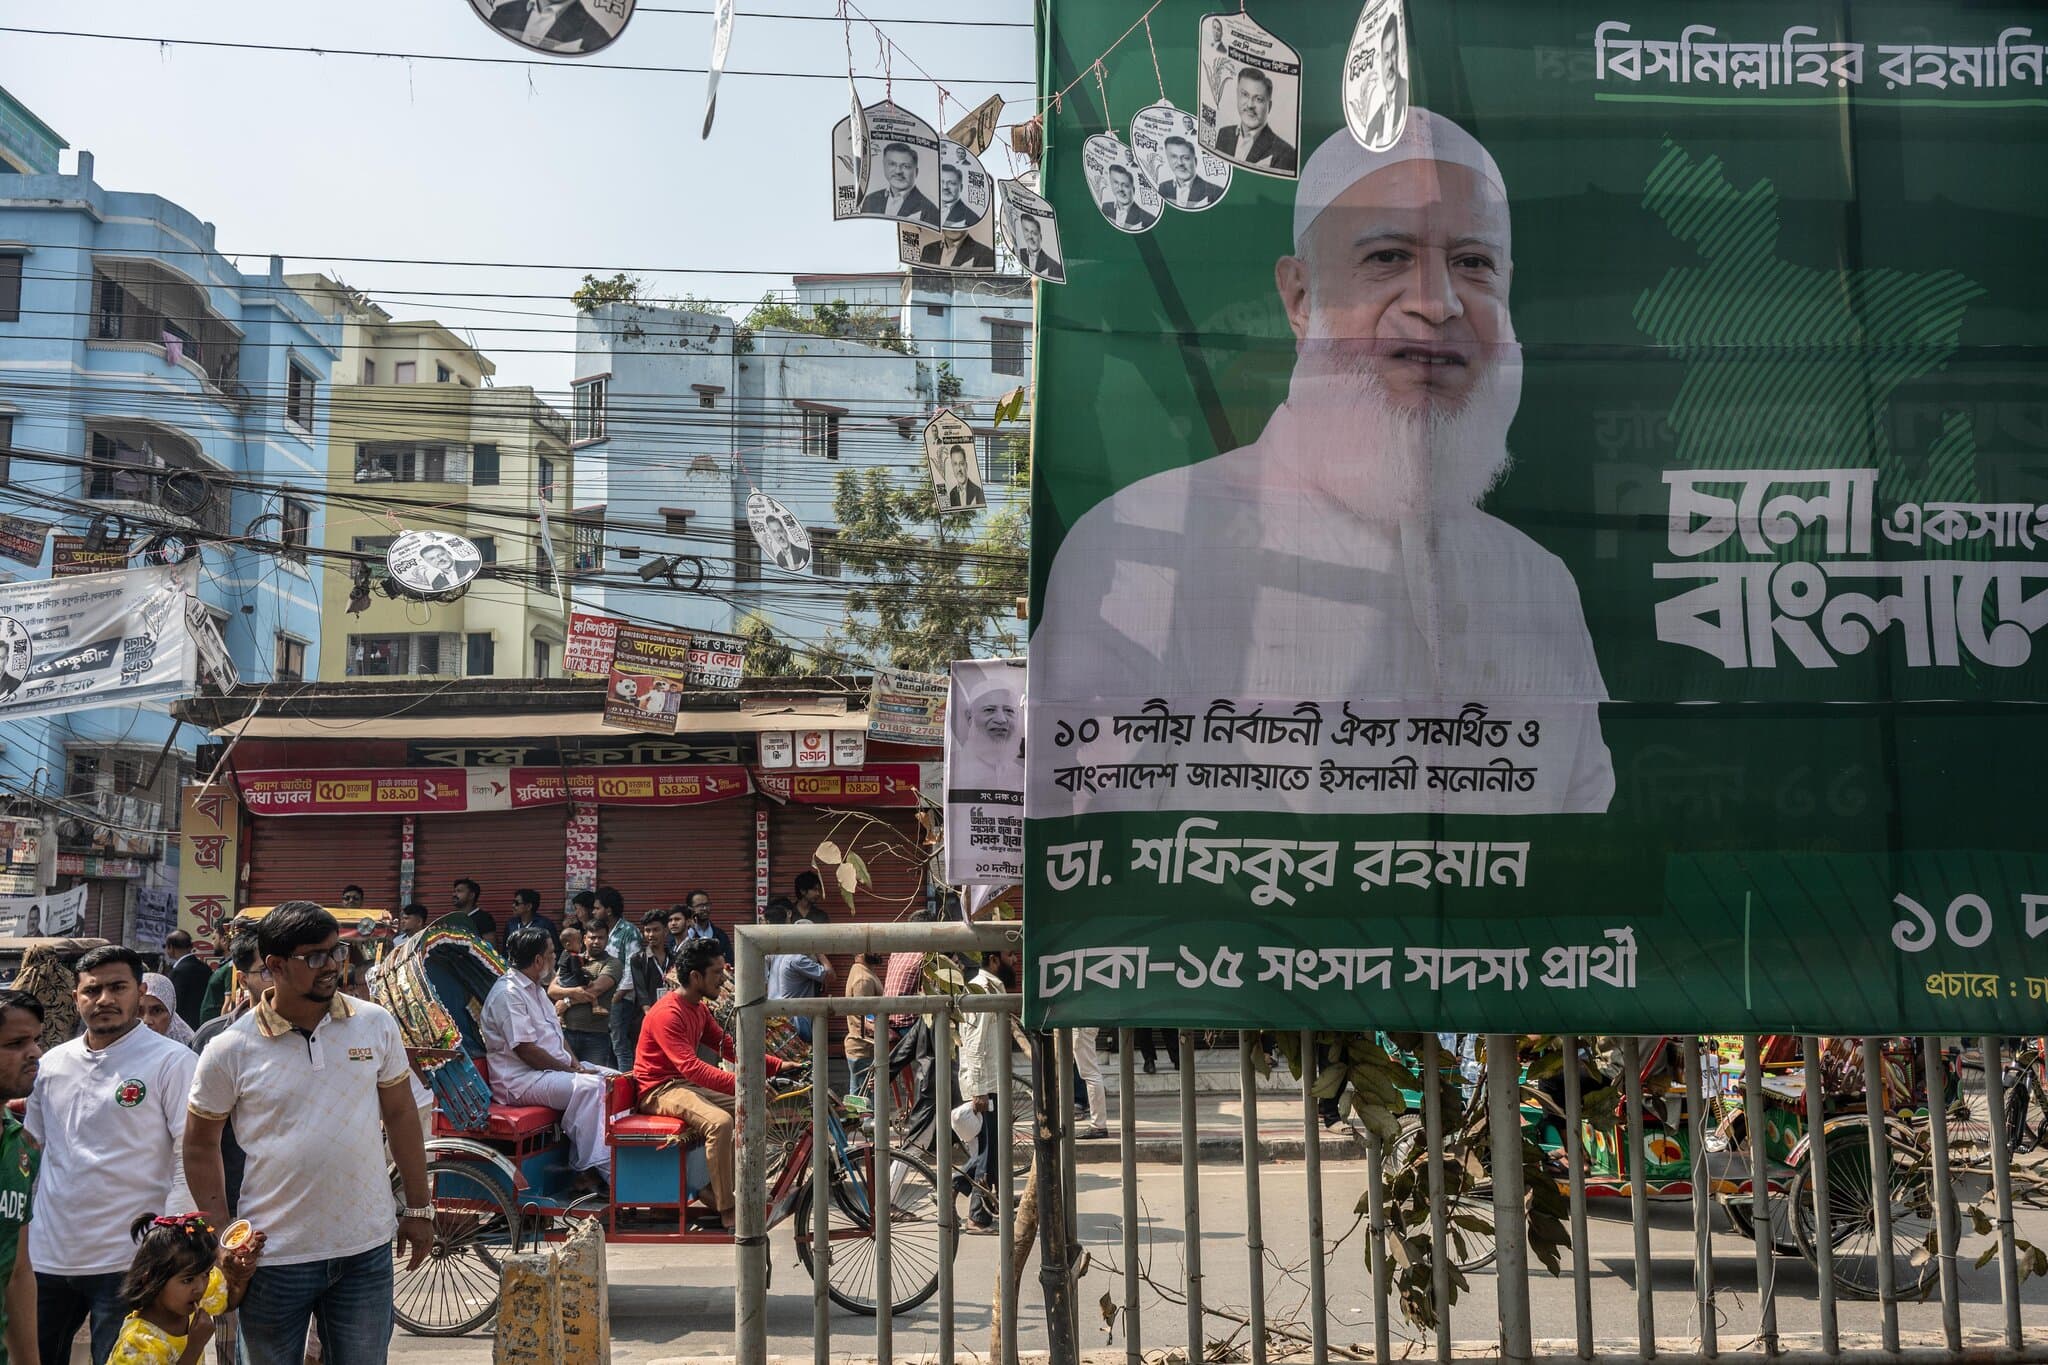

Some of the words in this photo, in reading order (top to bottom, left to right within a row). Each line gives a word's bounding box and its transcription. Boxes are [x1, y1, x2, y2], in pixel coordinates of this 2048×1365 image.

[1594, 20, 1865, 91] বিসমিল্লাহির
[1878, 27, 2048, 91] রহমানি
[1662, 469, 1879, 557] চলো
[633, 640, 686, 661] আলোড়ন
[711, 652, 743, 668] লেখা
[1054, 716, 1100, 747] ১০
[1112, 702, 1195, 747] দলীয়
[1203, 699, 1323, 746] নির্বাচনী
[1331, 700, 1397, 747] ঐক্য
[1406, 703, 1512, 749] সমর্থিত
[1518, 721, 1541, 747] ও
[799, 751, 826, 762] নগদ
[1054, 761, 1179, 795] বাংলাদেশ
[1186, 762, 1312, 792] জামায়াতে
[1319, 756, 1419, 793] ইসলামী
[1426, 757, 1538, 794] মনোনীত
[274, 790, 312, 804] ডাবল
[320, 783, 346, 801] ৫০
[515, 784, 555, 802] সুবিধা
[602, 780, 628, 796] ৫০
[970, 834, 1001, 846] সেবক
[975, 863, 990, 872] ১০
[991, 861, 1018, 874] দলীয়
[1045, 839, 1113, 892] ডা.
[1130, 817, 1340, 907] শফিকুর
[1353, 841, 1531, 893] রহমান
[1891, 892, 1994, 953] ১০
[1038, 945, 1245, 999] ঢাকা-১৫
[1257, 945, 1394, 992] সংসদ
[1404, 946, 1530, 992] সদস্য
[1539, 925, 1638, 992] প্রার্থী
[1925, 970, 2001, 1001] প্রচারে
